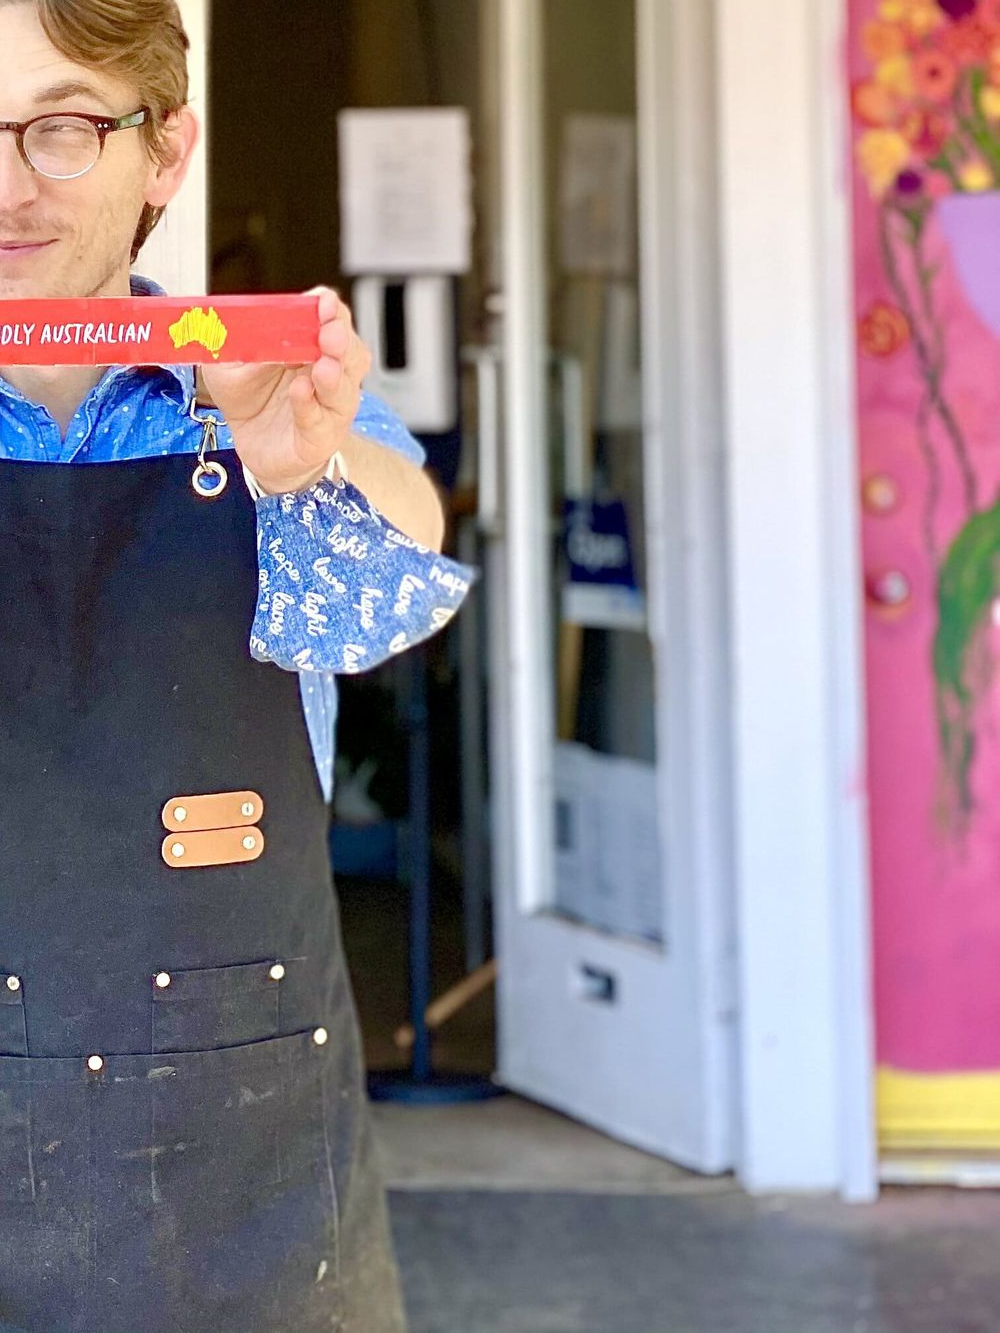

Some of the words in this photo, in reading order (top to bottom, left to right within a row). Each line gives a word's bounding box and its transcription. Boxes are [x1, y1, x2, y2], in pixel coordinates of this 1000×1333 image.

[40, 321, 152, 345] AUSTRALIAN
[268, 537, 301, 581] hope
[327, 524, 368, 560] light
[312, 556, 347, 594] love
[393, 573, 426, 616] love
[269, 591, 296, 636] love
[299, 590, 328, 637] light
[352, 587, 383, 630] hope
